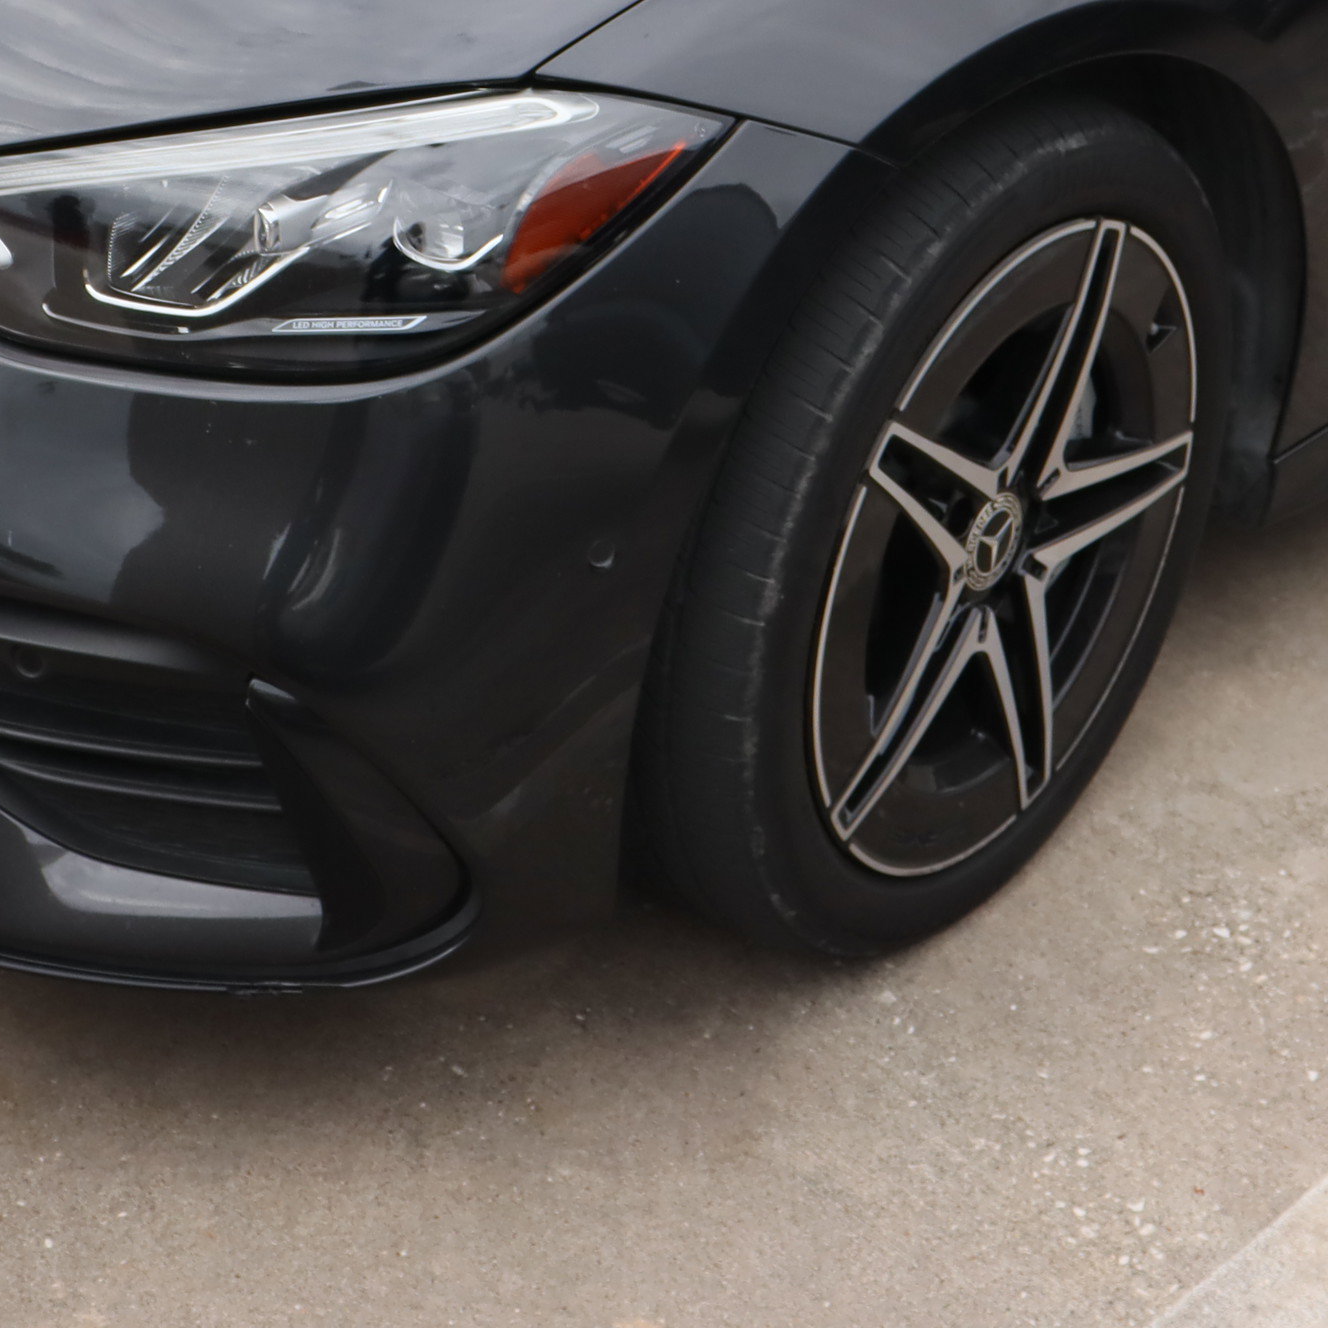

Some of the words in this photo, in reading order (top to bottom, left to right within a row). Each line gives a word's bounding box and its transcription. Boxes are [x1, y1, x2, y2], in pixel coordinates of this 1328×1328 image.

[292, 321, 309, 329] LED
[311, 321, 335, 329] HIGH
[336, 319, 404, 329] PERFORMANCE
